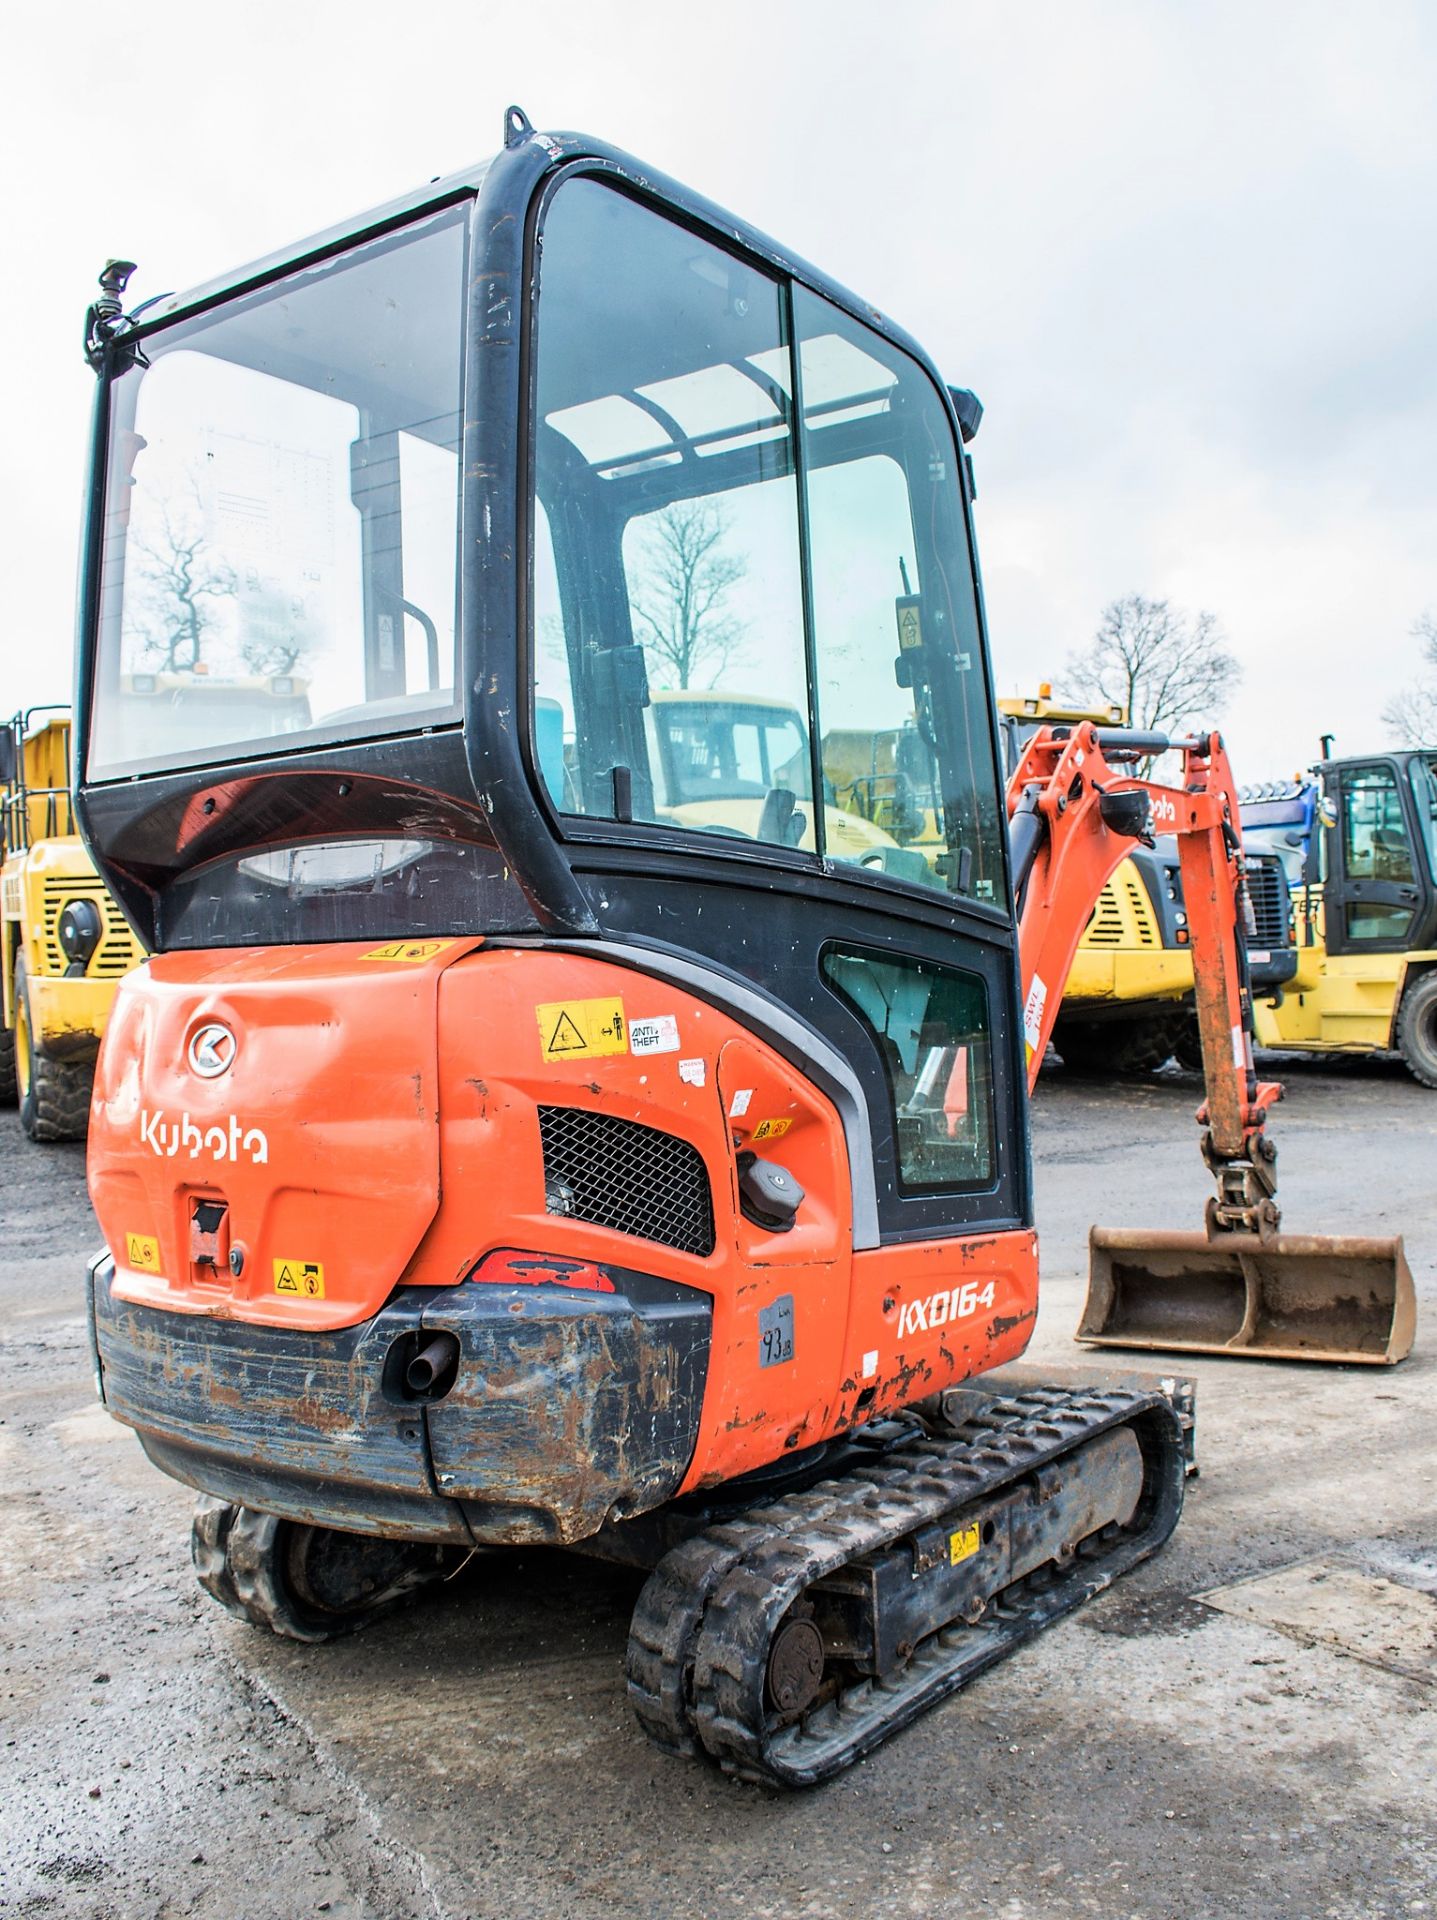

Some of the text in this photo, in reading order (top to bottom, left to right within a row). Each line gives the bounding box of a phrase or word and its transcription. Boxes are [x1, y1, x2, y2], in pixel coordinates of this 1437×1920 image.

[632, 1035, 660, 1048] THEFT
[141, 1110, 268, 1164] Kubota
[897, 1281, 995, 1339] KX016-4
[763, 1327, 781, 1362] 93
